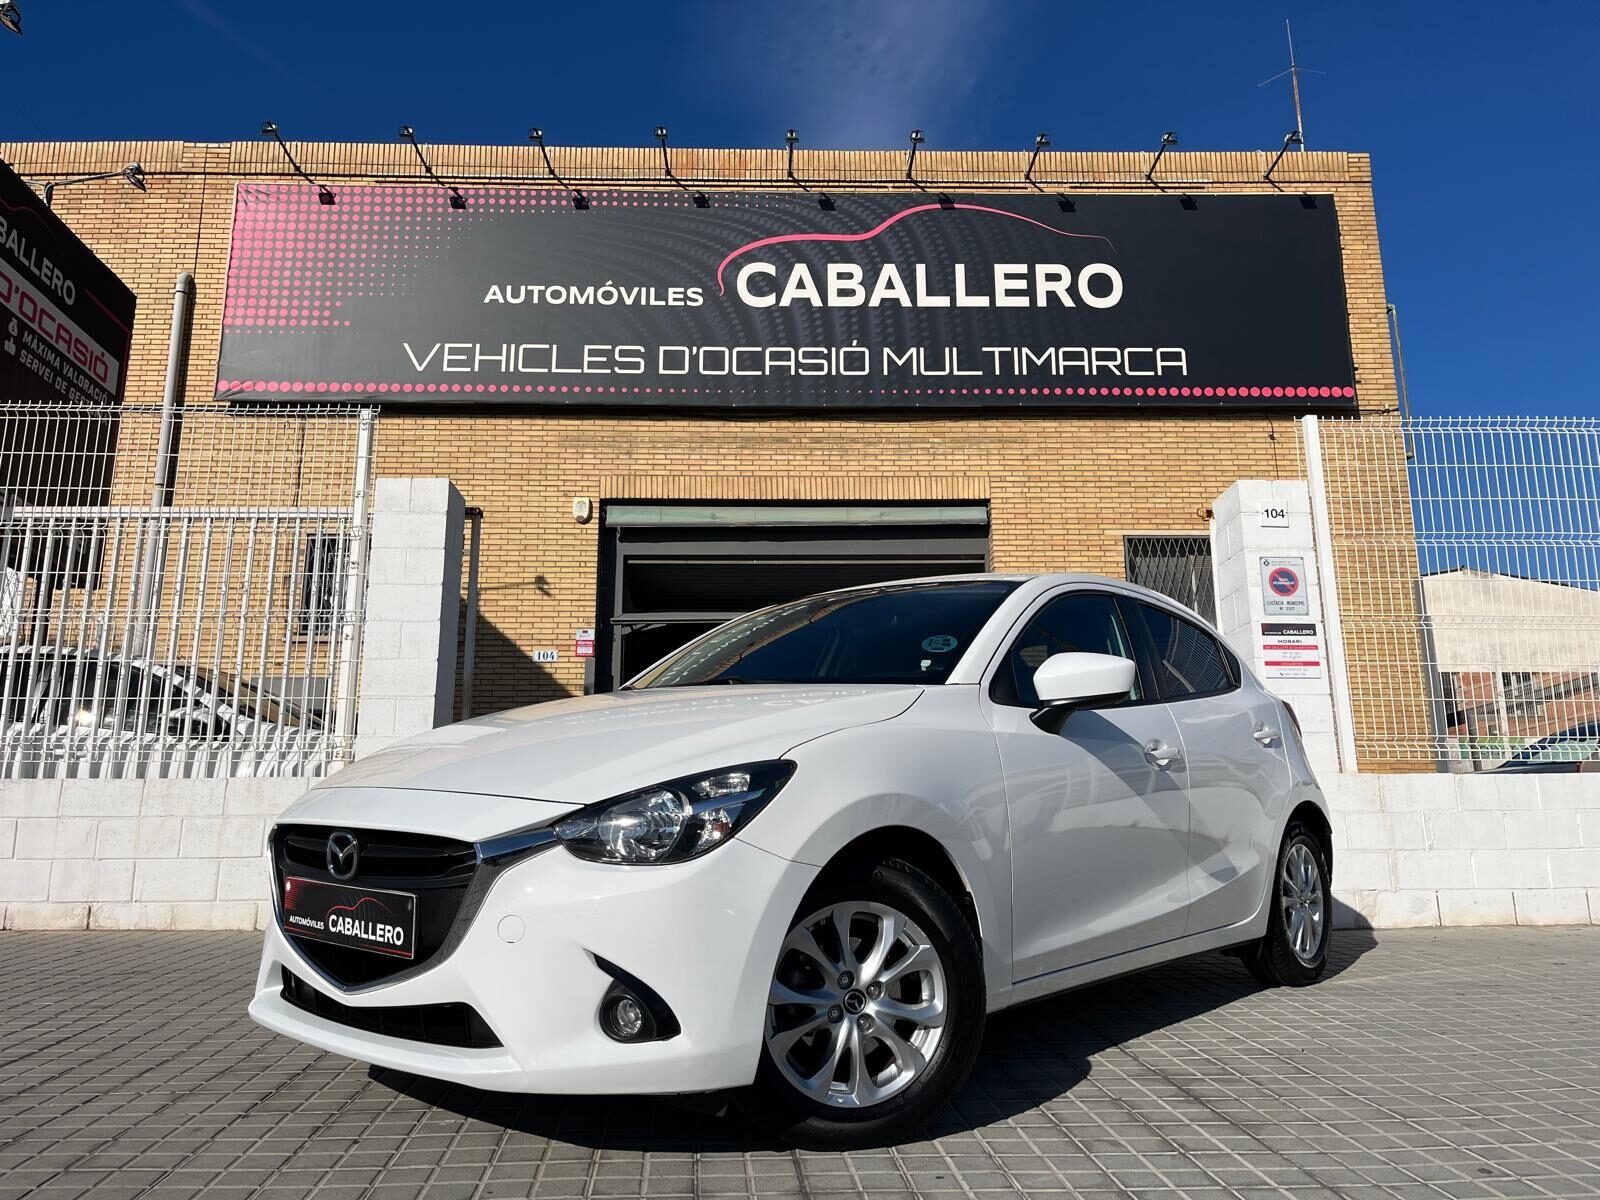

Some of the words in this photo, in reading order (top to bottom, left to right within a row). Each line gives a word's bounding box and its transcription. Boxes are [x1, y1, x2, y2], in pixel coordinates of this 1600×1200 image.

[483, 279, 704, 307] AUTOMÓVILES
[736, 262, 1123, 309] CABALLERO
[19, 349, 54, 384] SERVEI
[54, 378, 68, 394] DE
[403, 342, 646, 374] VEHICLES
[658, 340, 870, 376] D'OCASIÓ
[882, 346, 1188, 376] MULTIMARCA
[1264, 508, 1286, 519] 104
[537, 651, 555, 661] 104
[289, 915, 325, 930] AUTOMÓVILES
[328, 914, 404, 947] CABALLERO
